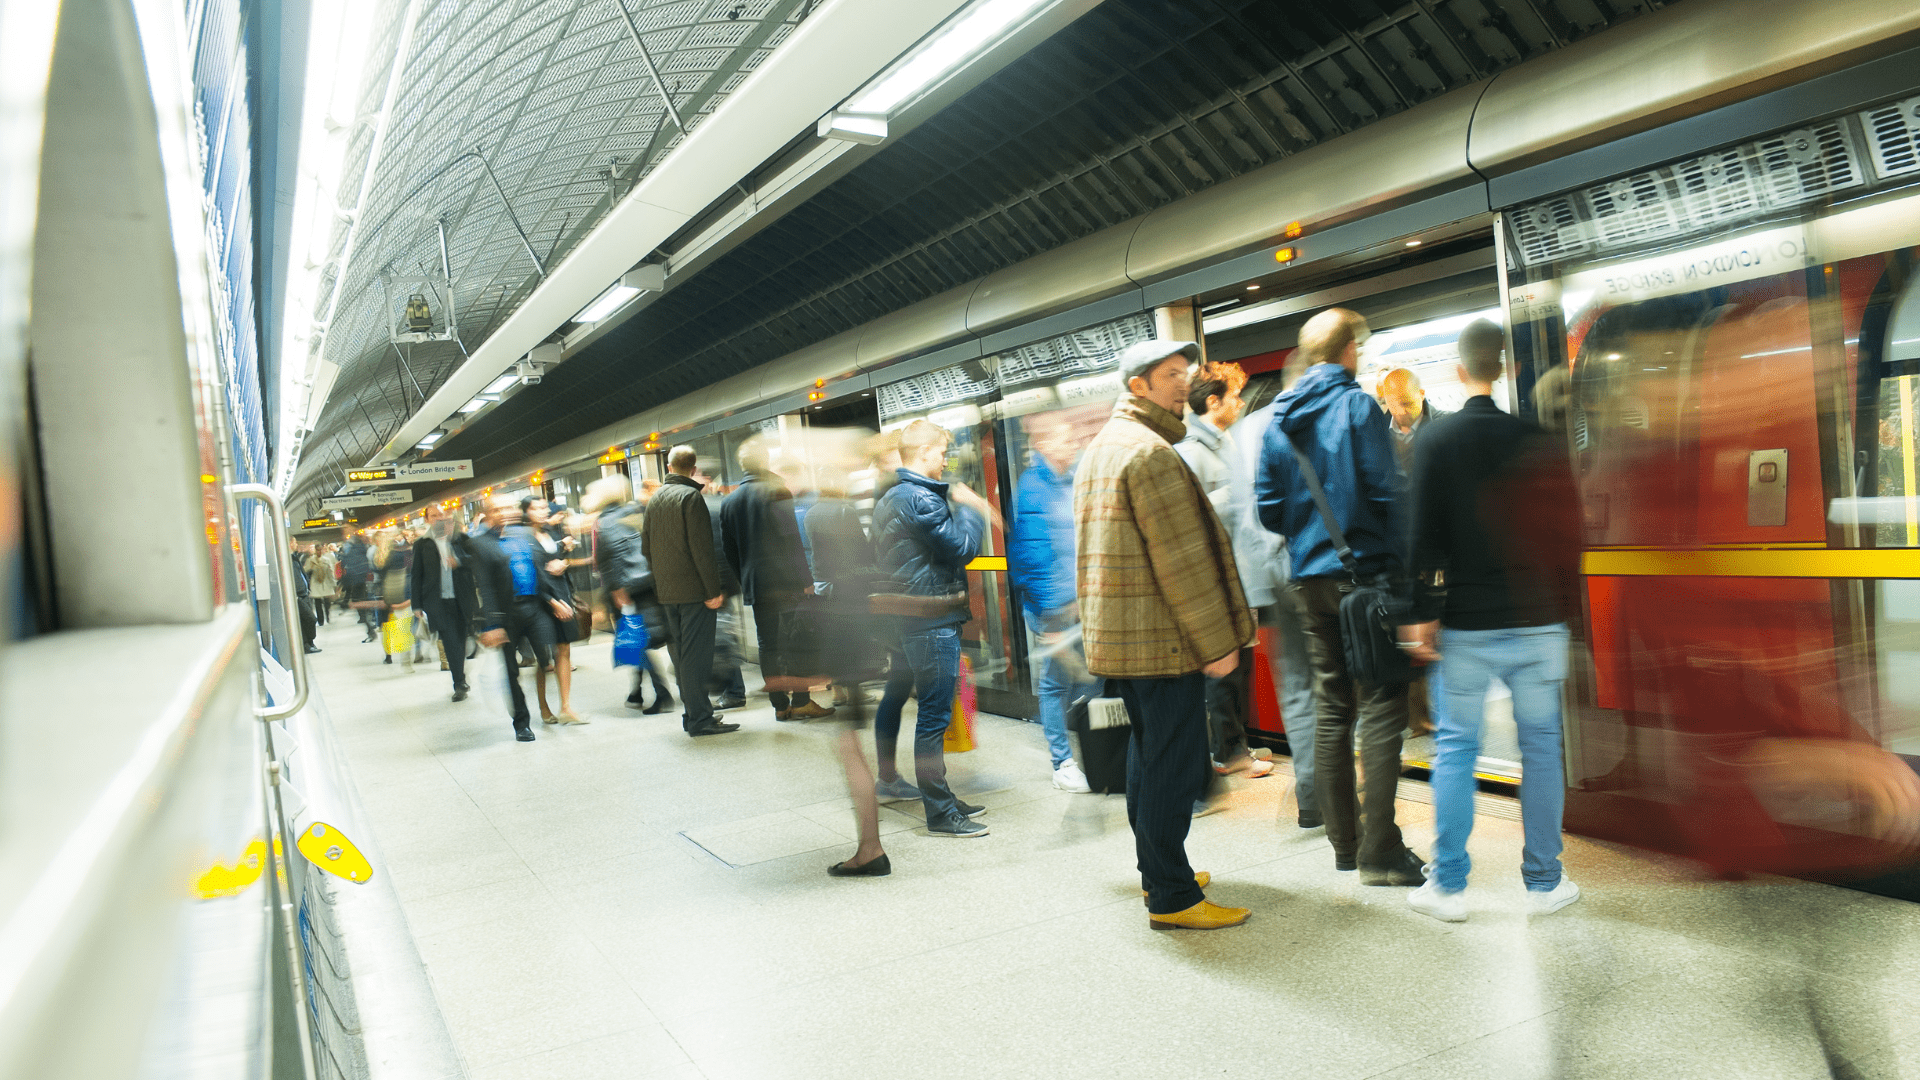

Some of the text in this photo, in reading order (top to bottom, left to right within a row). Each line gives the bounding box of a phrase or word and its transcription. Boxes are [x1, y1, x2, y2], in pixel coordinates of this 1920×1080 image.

[357, 470, 387, 479] Way out
[408, 465, 456, 475] London Bridge
